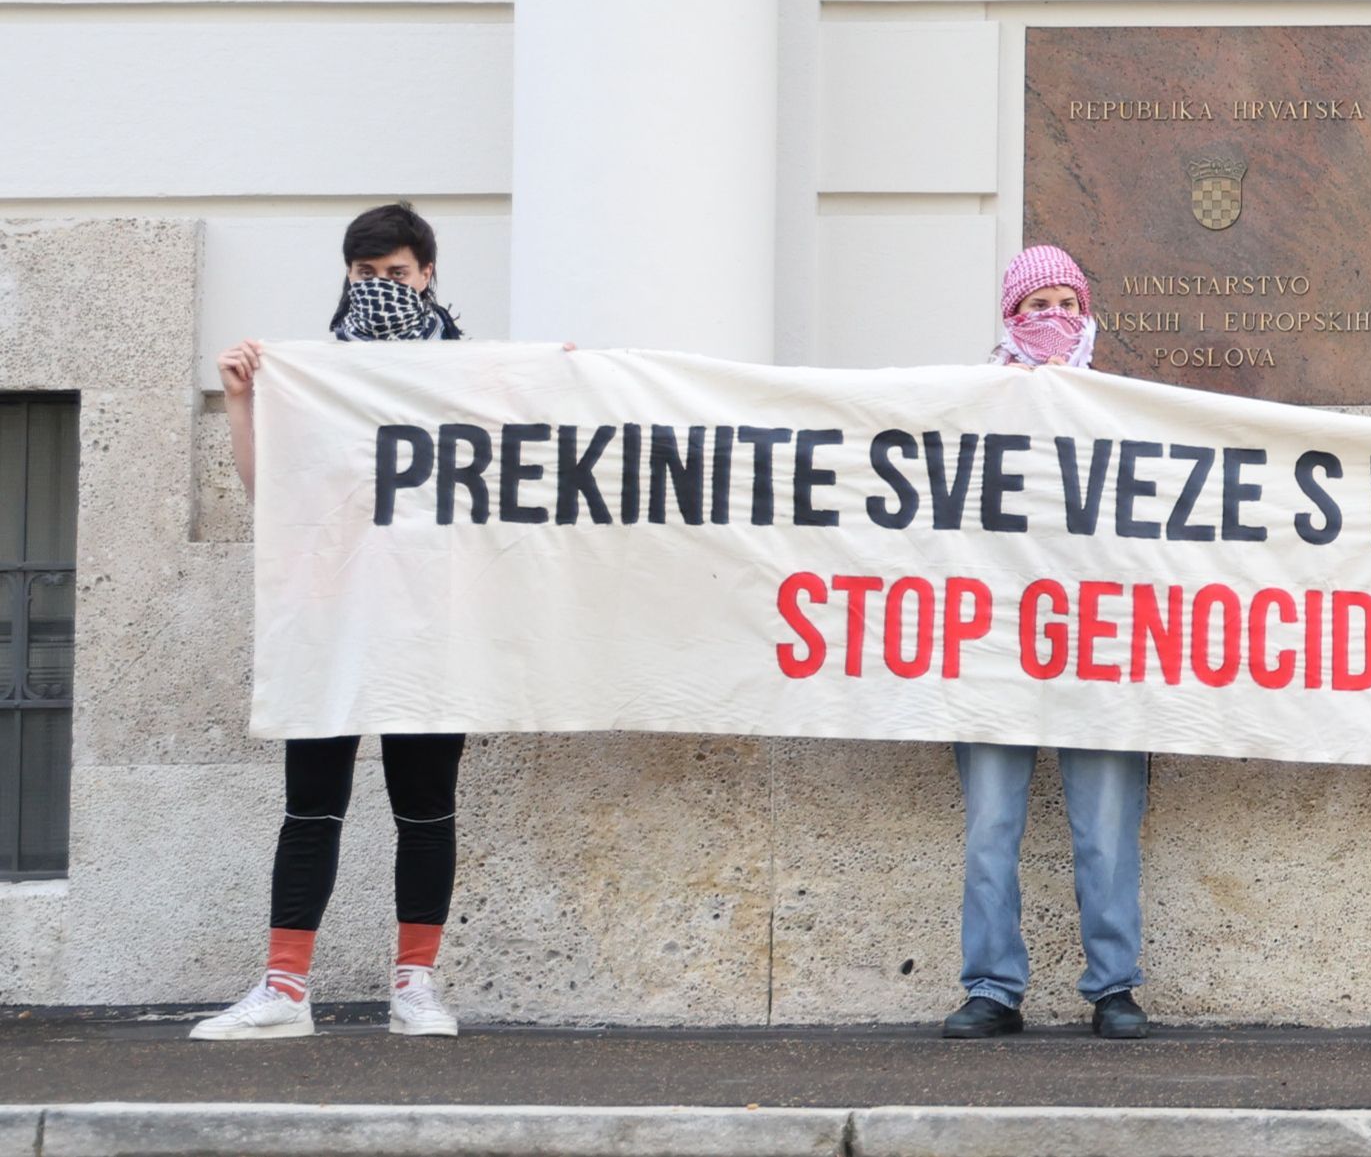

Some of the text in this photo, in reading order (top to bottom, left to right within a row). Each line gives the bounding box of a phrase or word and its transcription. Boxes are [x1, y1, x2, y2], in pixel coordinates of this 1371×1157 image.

[1069, 99, 1365, 121] REPUBLIKA HRVATSKA
[1121, 275, 1311, 296] MINISTARSTVO
[1094, 311, 1371, 332] NJSKIH I EUROPSKIH
[1154, 347, 1277, 368] POSLOVA
[373, 422, 844, 526] PREKINITE
[865, 428, 1031, 533] SVE
[1054, 436, 1268, 542] VEZE
[1293, 450, 1344, 546] S
[775, 571, 993, 681] STOP
